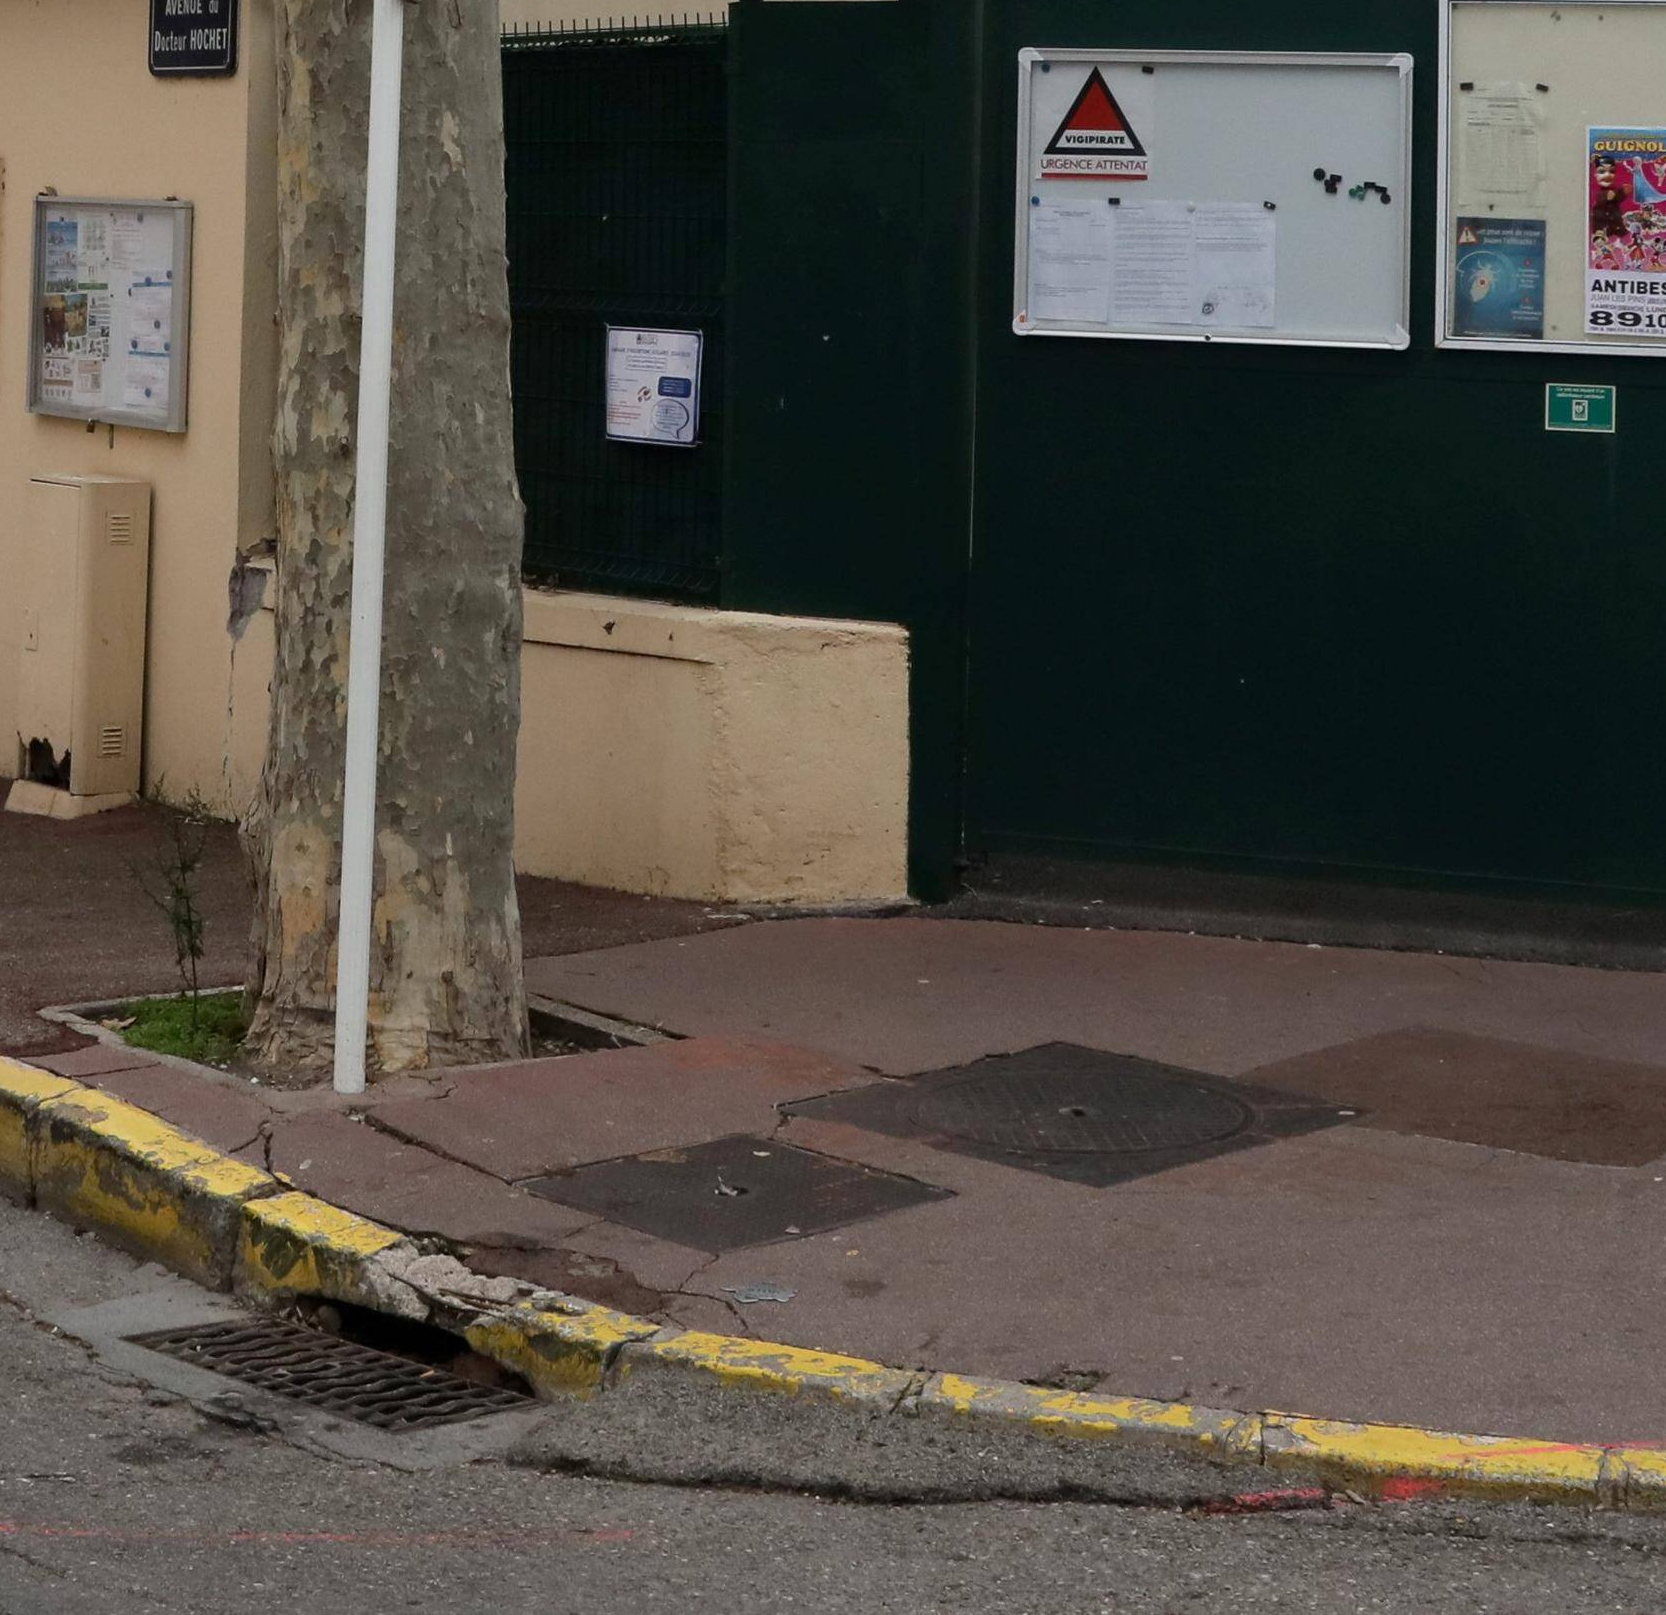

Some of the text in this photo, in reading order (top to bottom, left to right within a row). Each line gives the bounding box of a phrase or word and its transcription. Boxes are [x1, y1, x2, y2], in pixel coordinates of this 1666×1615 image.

[154, 27, 228, 52] Docteur HOCHET
[1065, 135, 1126, 145] VIGIPIRATE
[1040, 158, 1148, 171] URGENCE ATTENTAT
[1589, 310, 1615, 326] 8
[1617, 311, 1643, 327] 9
